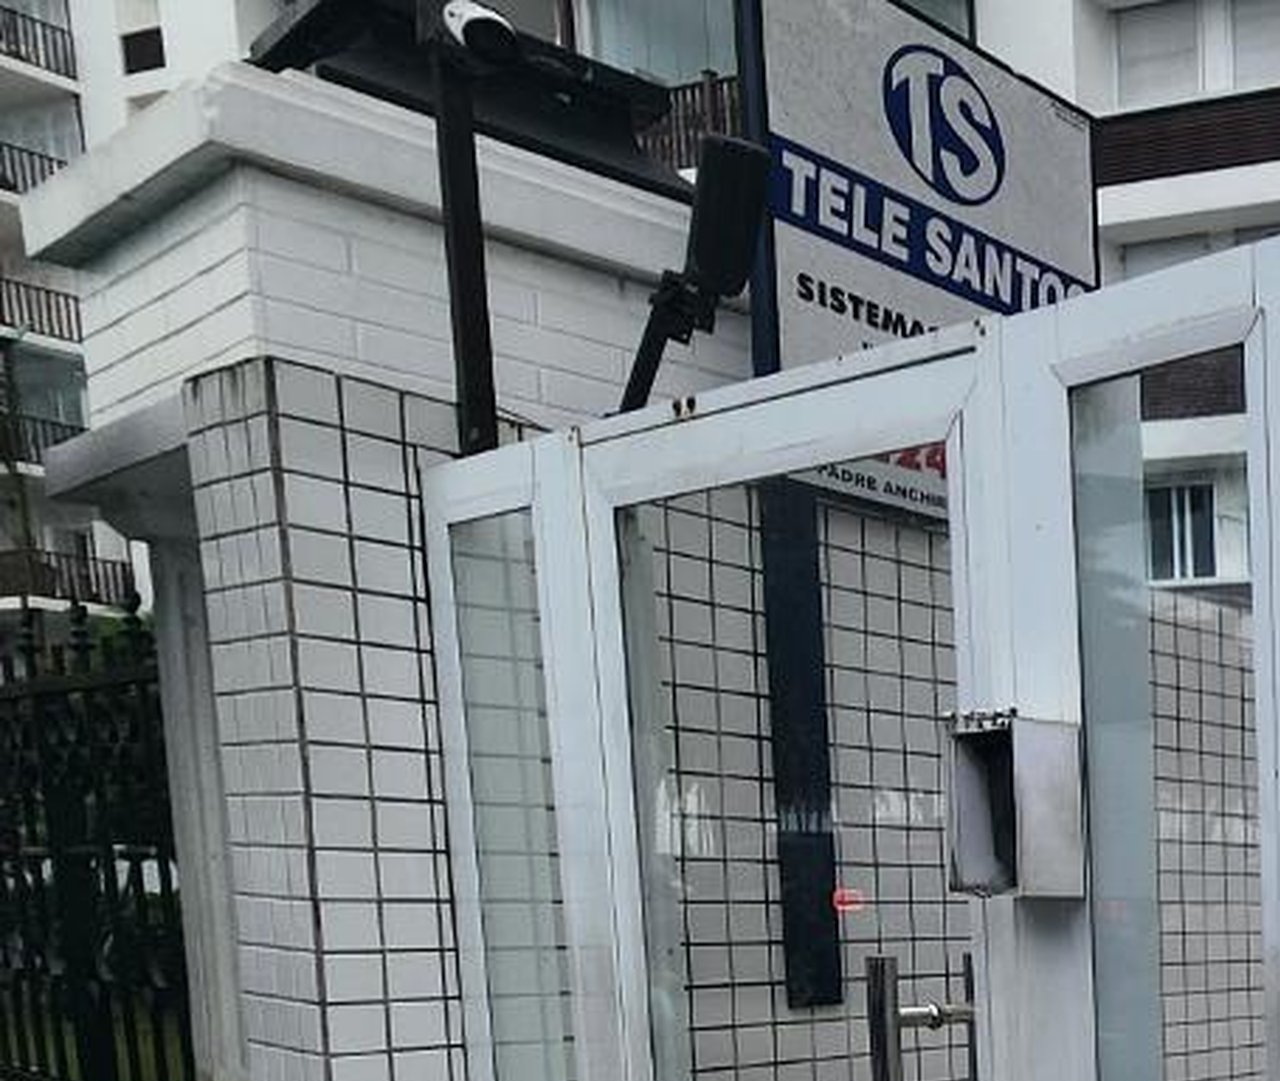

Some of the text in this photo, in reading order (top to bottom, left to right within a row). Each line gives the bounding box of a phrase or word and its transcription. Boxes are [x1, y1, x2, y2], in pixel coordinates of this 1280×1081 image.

[892, 52, 998, 200] TS
[782, 149, 1085, 312] TELE SANTO
[796, 272, 939, 338] SISTEMA
